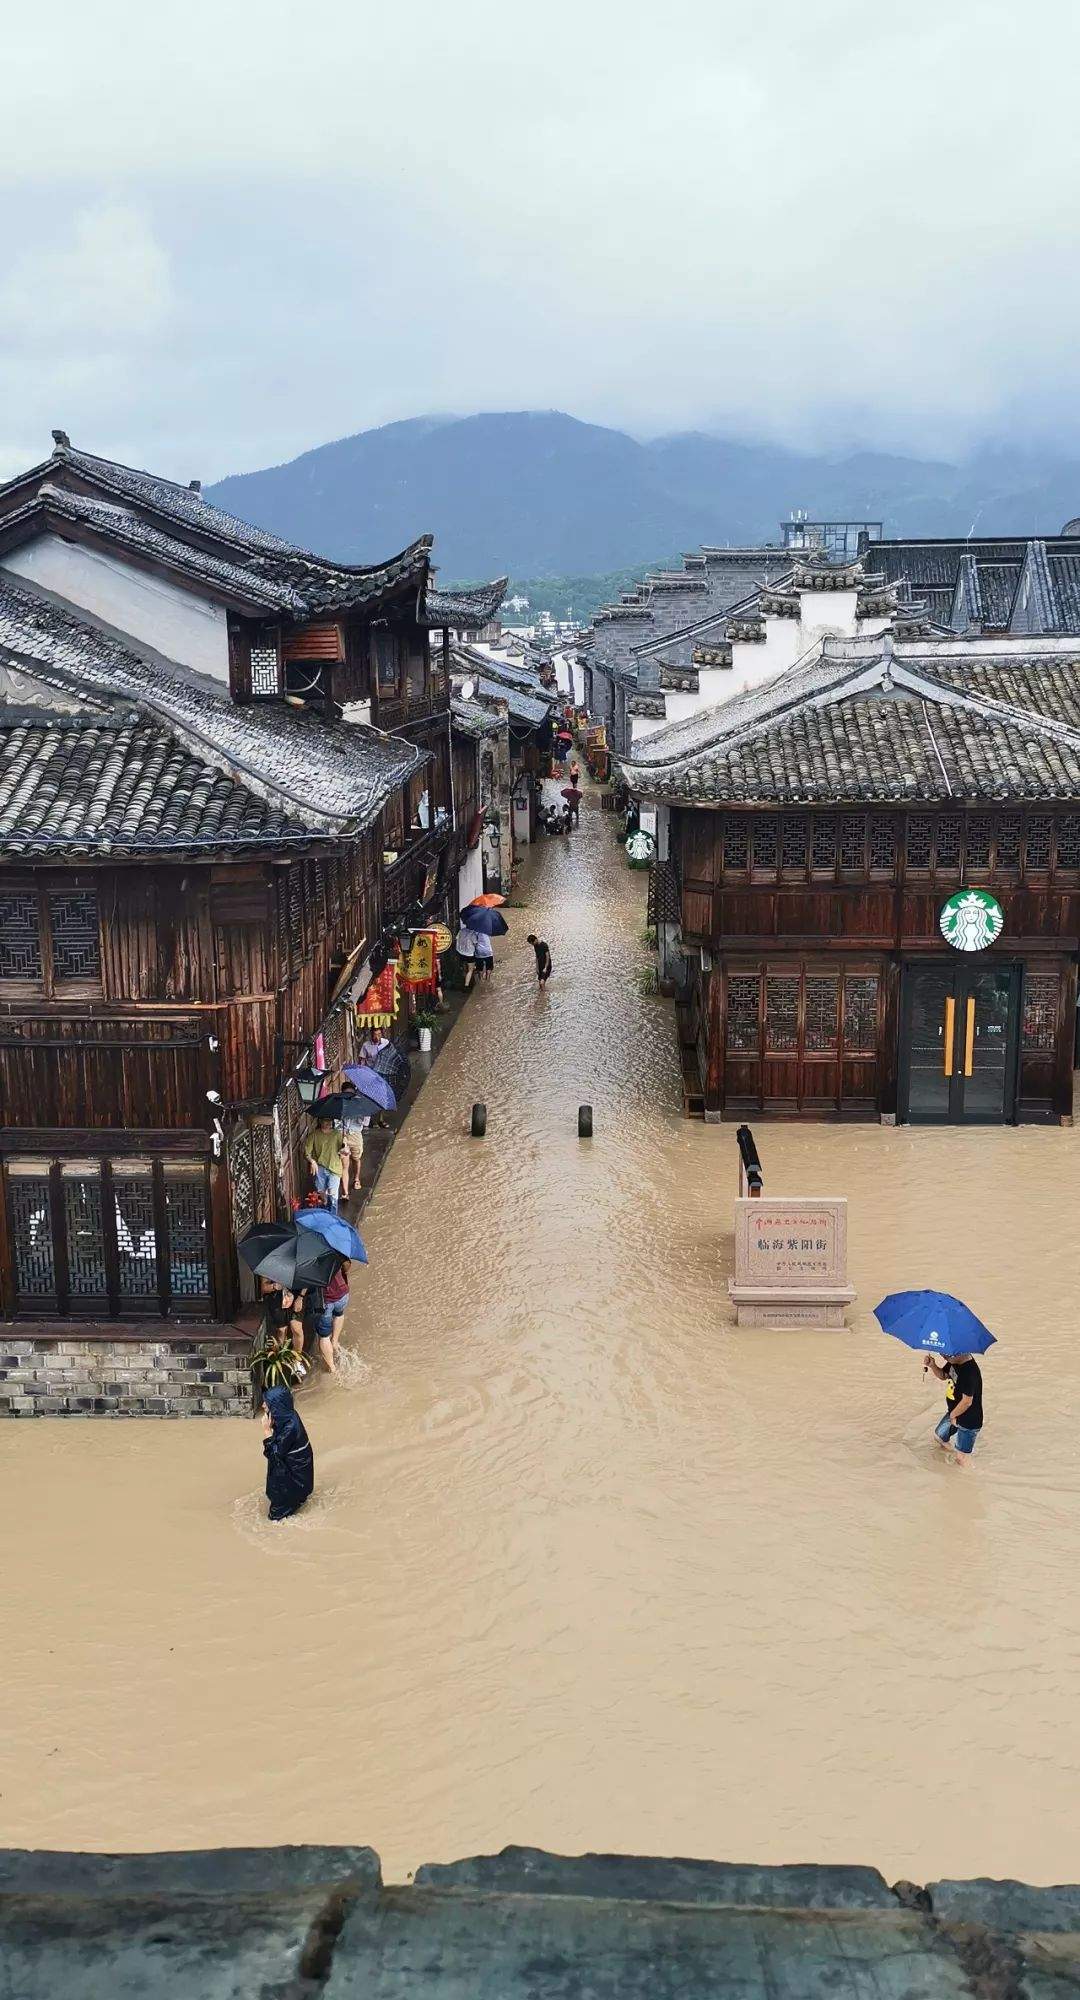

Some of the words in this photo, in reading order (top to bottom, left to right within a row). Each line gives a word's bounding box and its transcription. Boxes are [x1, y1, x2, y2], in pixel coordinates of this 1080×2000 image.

[757, 1239, 827, 1250] 临海紫阳街
